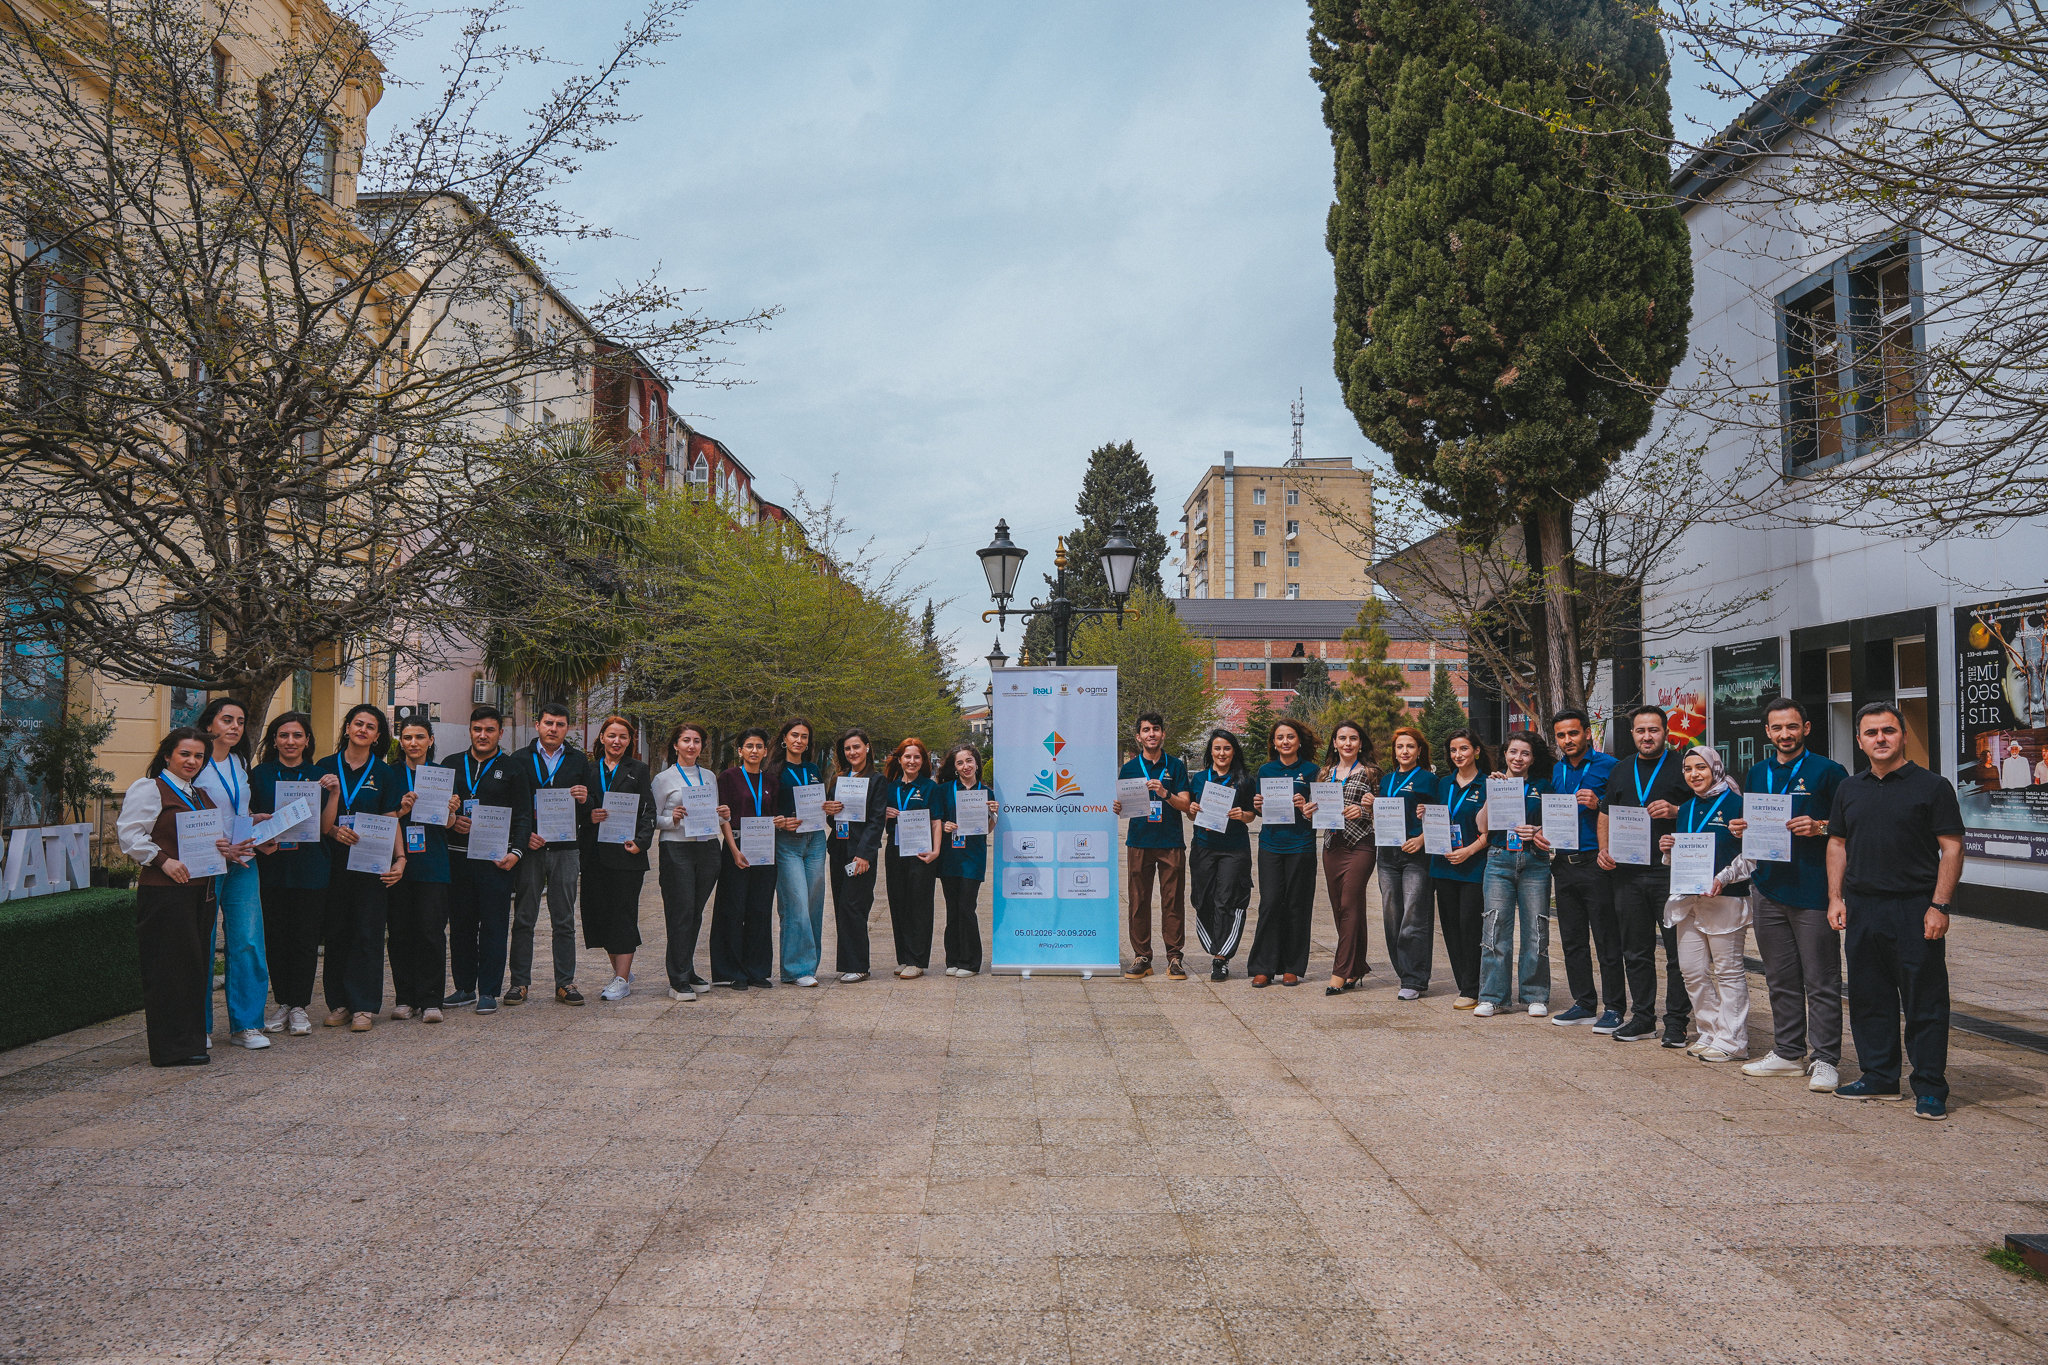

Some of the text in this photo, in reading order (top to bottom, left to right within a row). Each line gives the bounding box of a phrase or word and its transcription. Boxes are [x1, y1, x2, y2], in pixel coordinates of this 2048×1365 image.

[1968, 666, 1976, 682] THE
[1977, 660, 1999, 681] MÜ
[1745, 682, 1752, 690] 44
[1968, 683, 2000, 704] QƏS
[1969, 704, 2001, 724] SİR
[1003, 804, 1054, 813] ÖYRƏNMƏK
[1056, 804, 1080, 815] ÜÇÜN
[1965, 842, 1983, 851] TARİX:
[0, 823, 93, 903] AN
